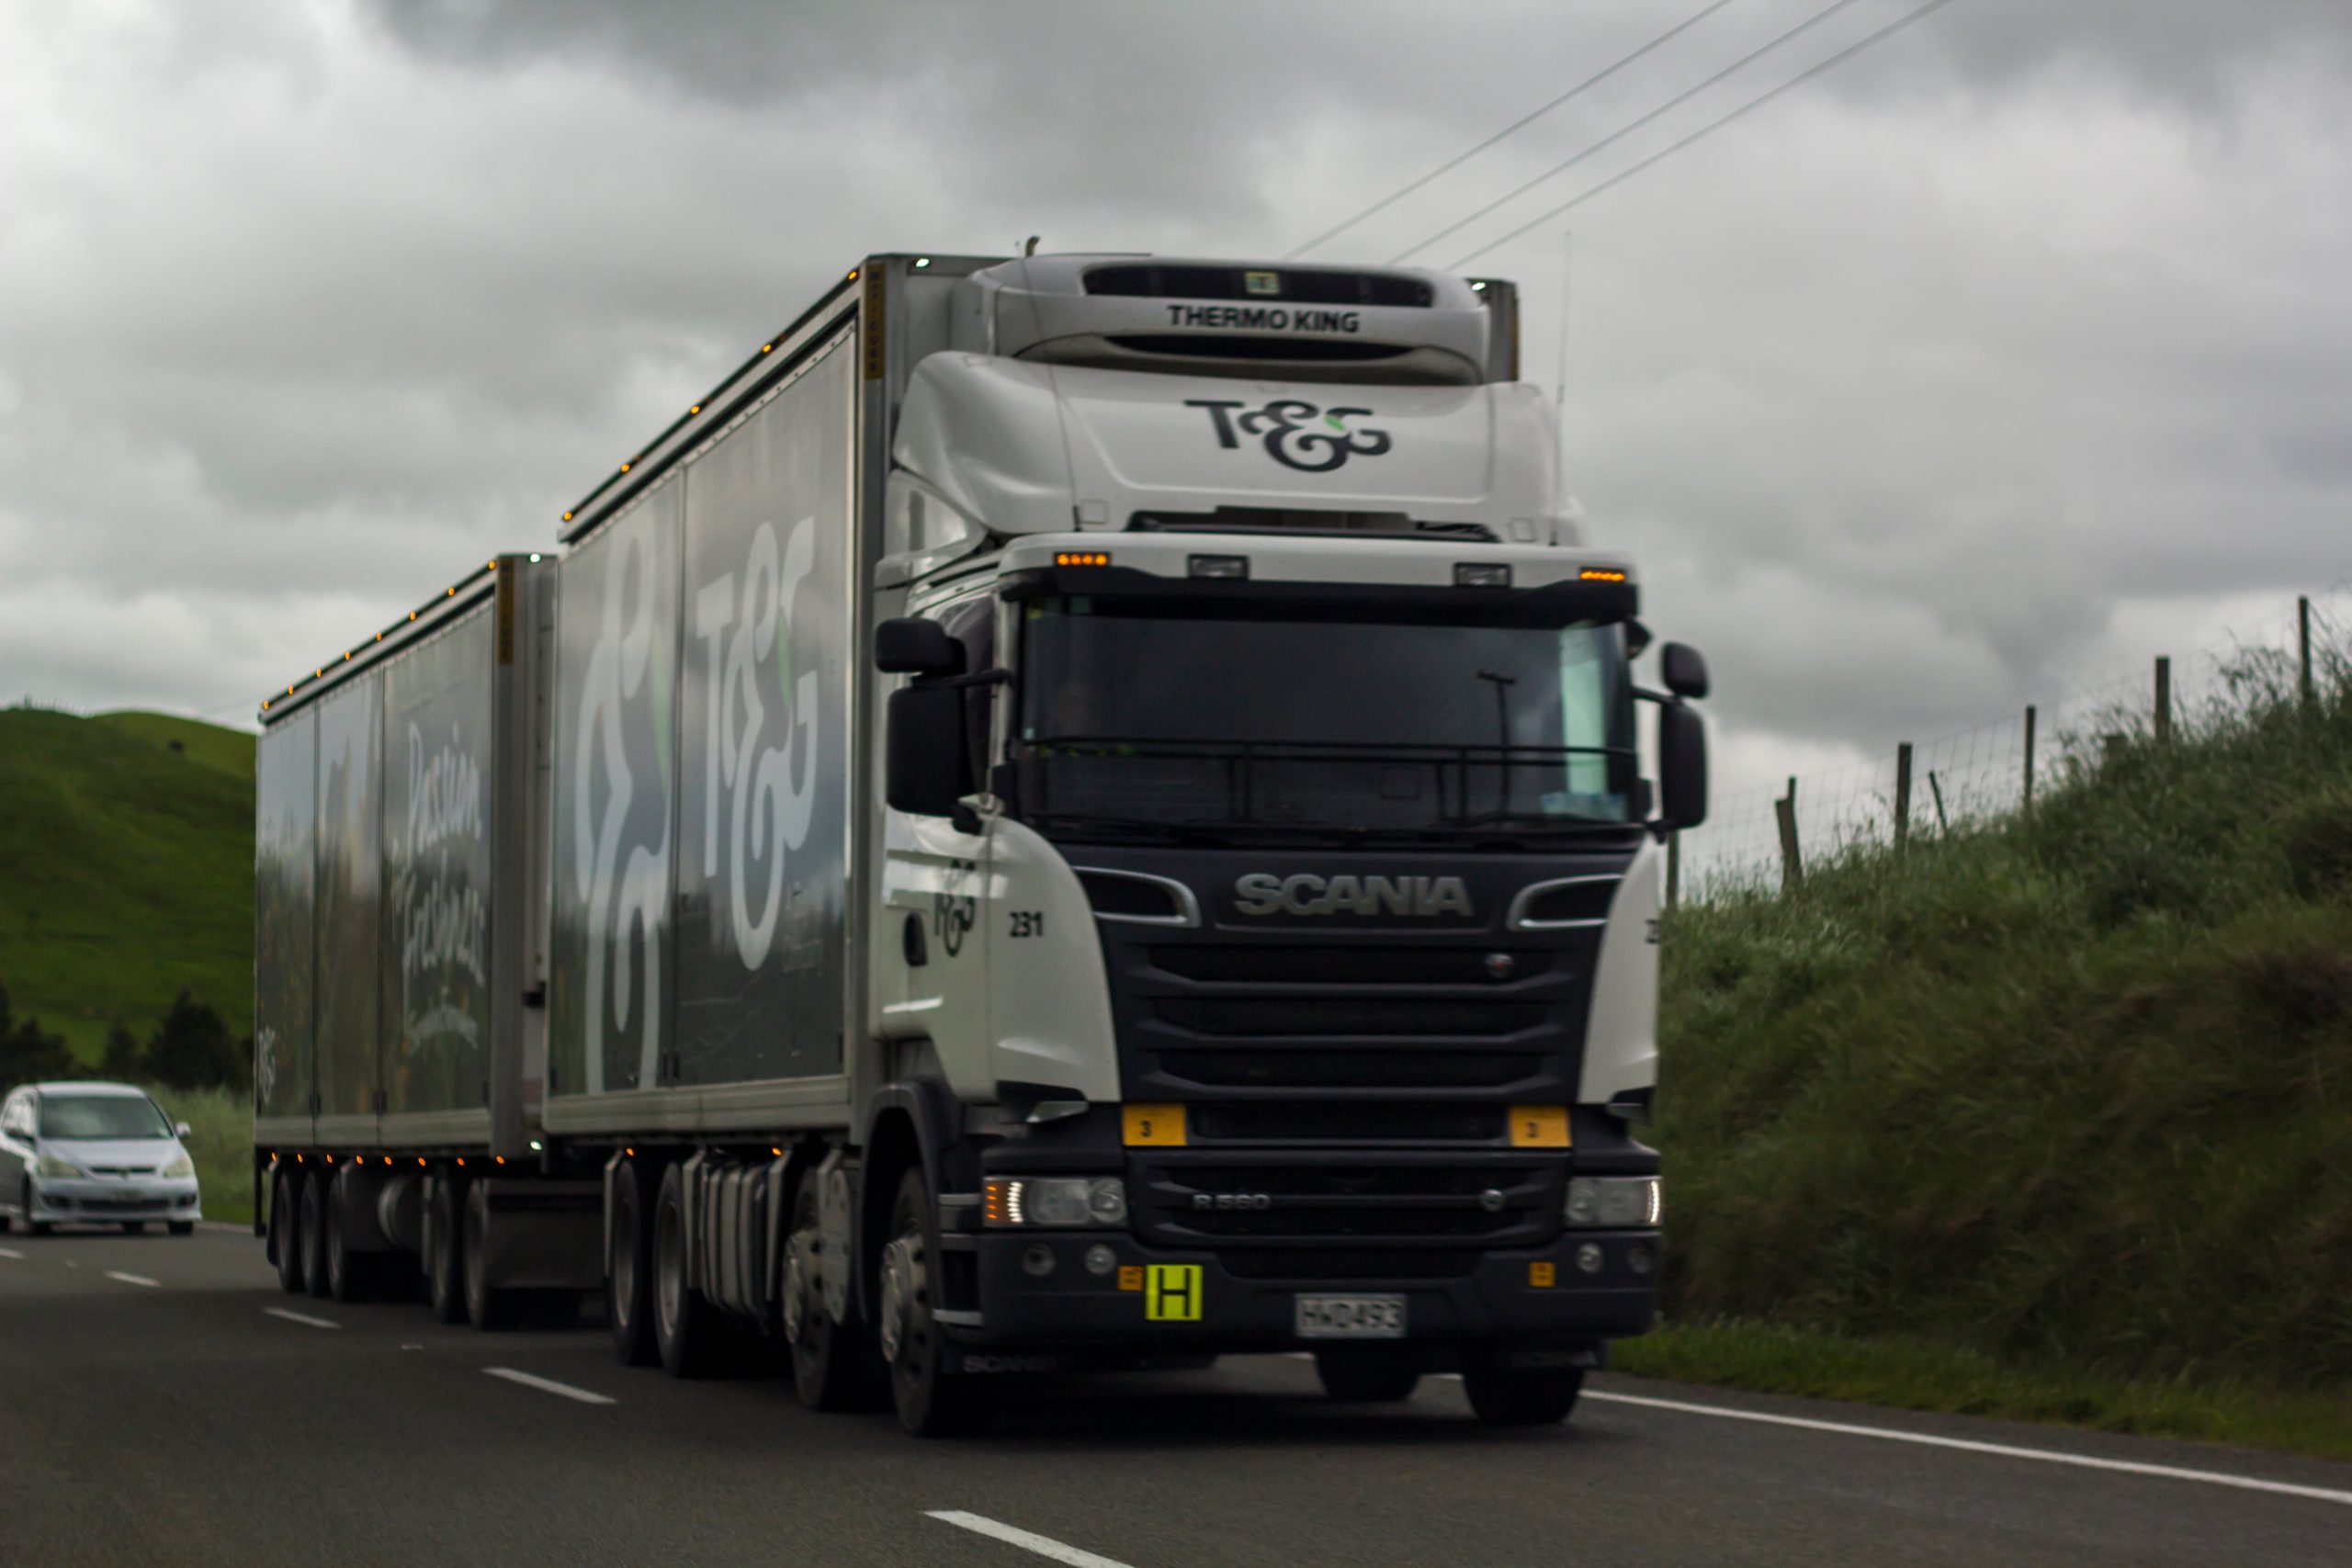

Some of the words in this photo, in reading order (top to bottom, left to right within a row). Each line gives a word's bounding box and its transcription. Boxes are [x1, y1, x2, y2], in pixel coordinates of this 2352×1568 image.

[1167, 305, 1287, 330] THERMO
[1294, 310, 1360, 333] KING
[1182, 399, 1391, 472] T&G
[696, 516, 817, 971] T&G
[1234, 873, 1474, 916] SCANIA
[1009, 910, 1044, 938] 231
[1193, 1193, 1213, 1211] R
[1156, 1267, 1192, 1318] H
